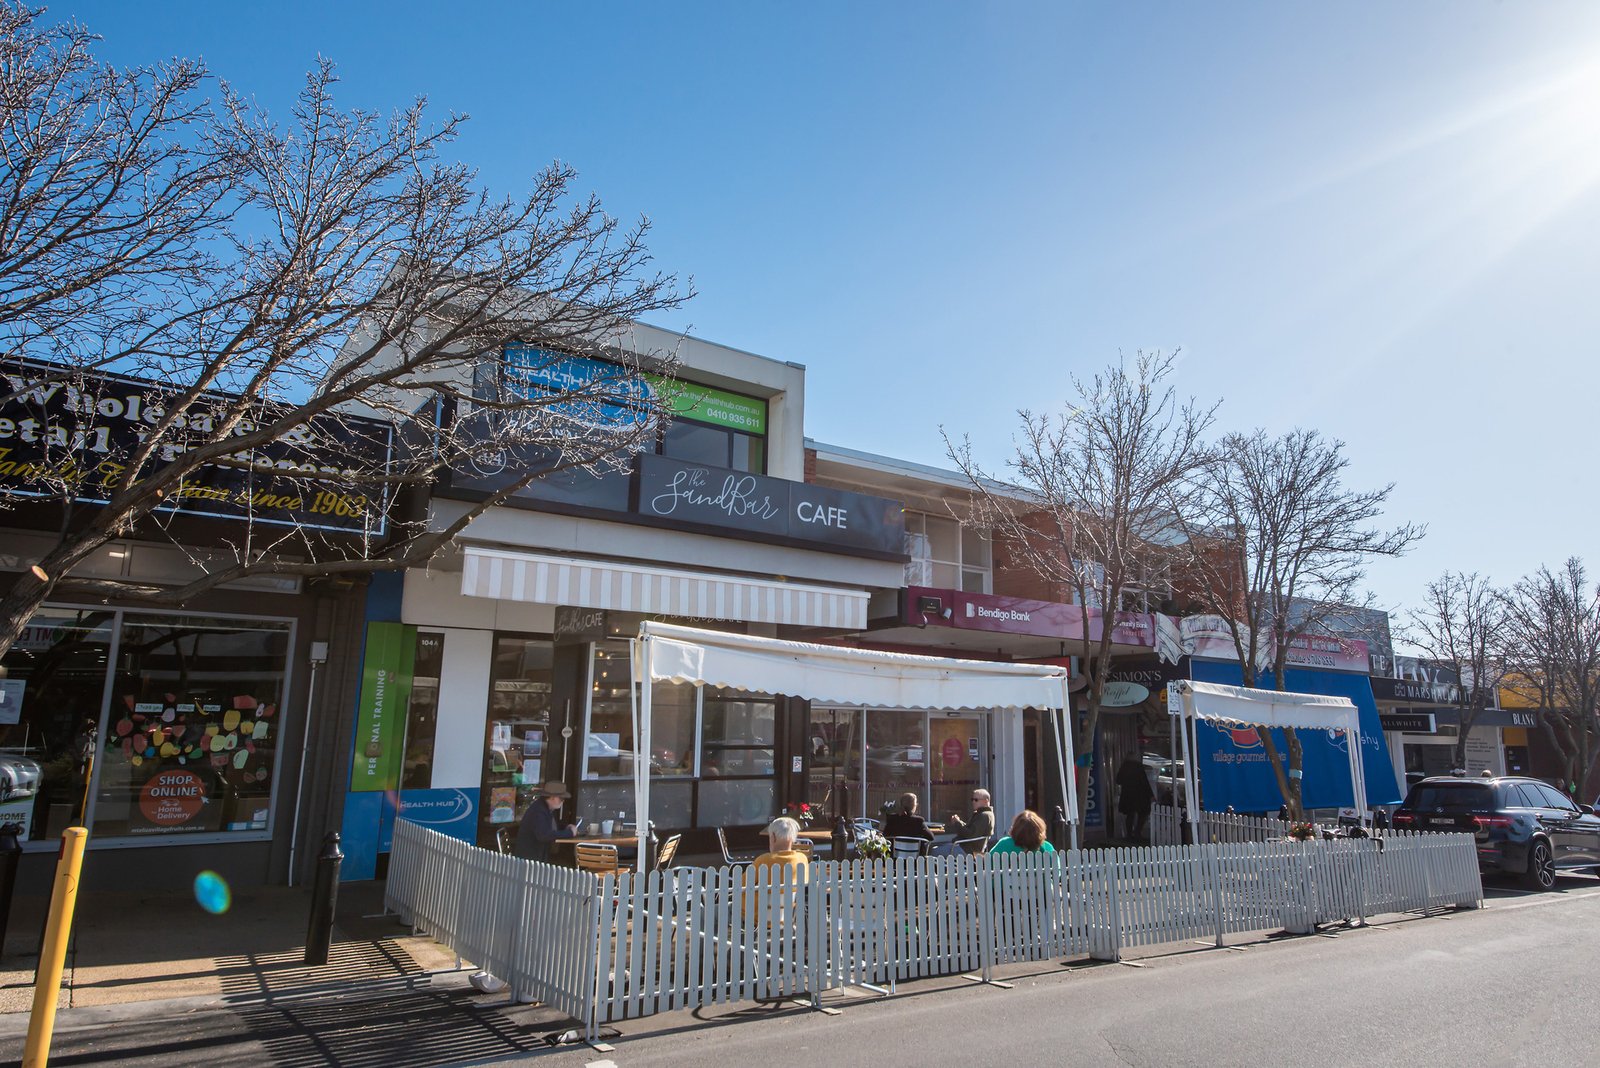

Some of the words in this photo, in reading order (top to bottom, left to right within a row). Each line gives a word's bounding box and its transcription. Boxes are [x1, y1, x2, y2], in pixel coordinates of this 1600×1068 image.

[707, 407, 727, 420] 0410
[728, 414, 745, 424] 935
[746, 417, 760, 428] 611
[309, 490, 368, 518] 1963
[797, 502, 847, 529] CAFE
[585, 612, 604, 628] CAFE
[978, 607, 1009, 622] Bendigo
[1011, 610, 1030, 622] Bank
[1112, 670, 1162, 682] SIMON'S
[373, 669, 387, 719] TRAINING
[1382, 719, 1423, 727] ALLWHITE
[367, 721, 382, 776] PERONAL
[1212, 751, 1235, 765] village
[1237, 751, 1266, 765] gourmet
[160, 775, 193, 785] SHOP
[150, 786, 198, 797] ONLINE
[157, 812, 191, 820] Delivery
